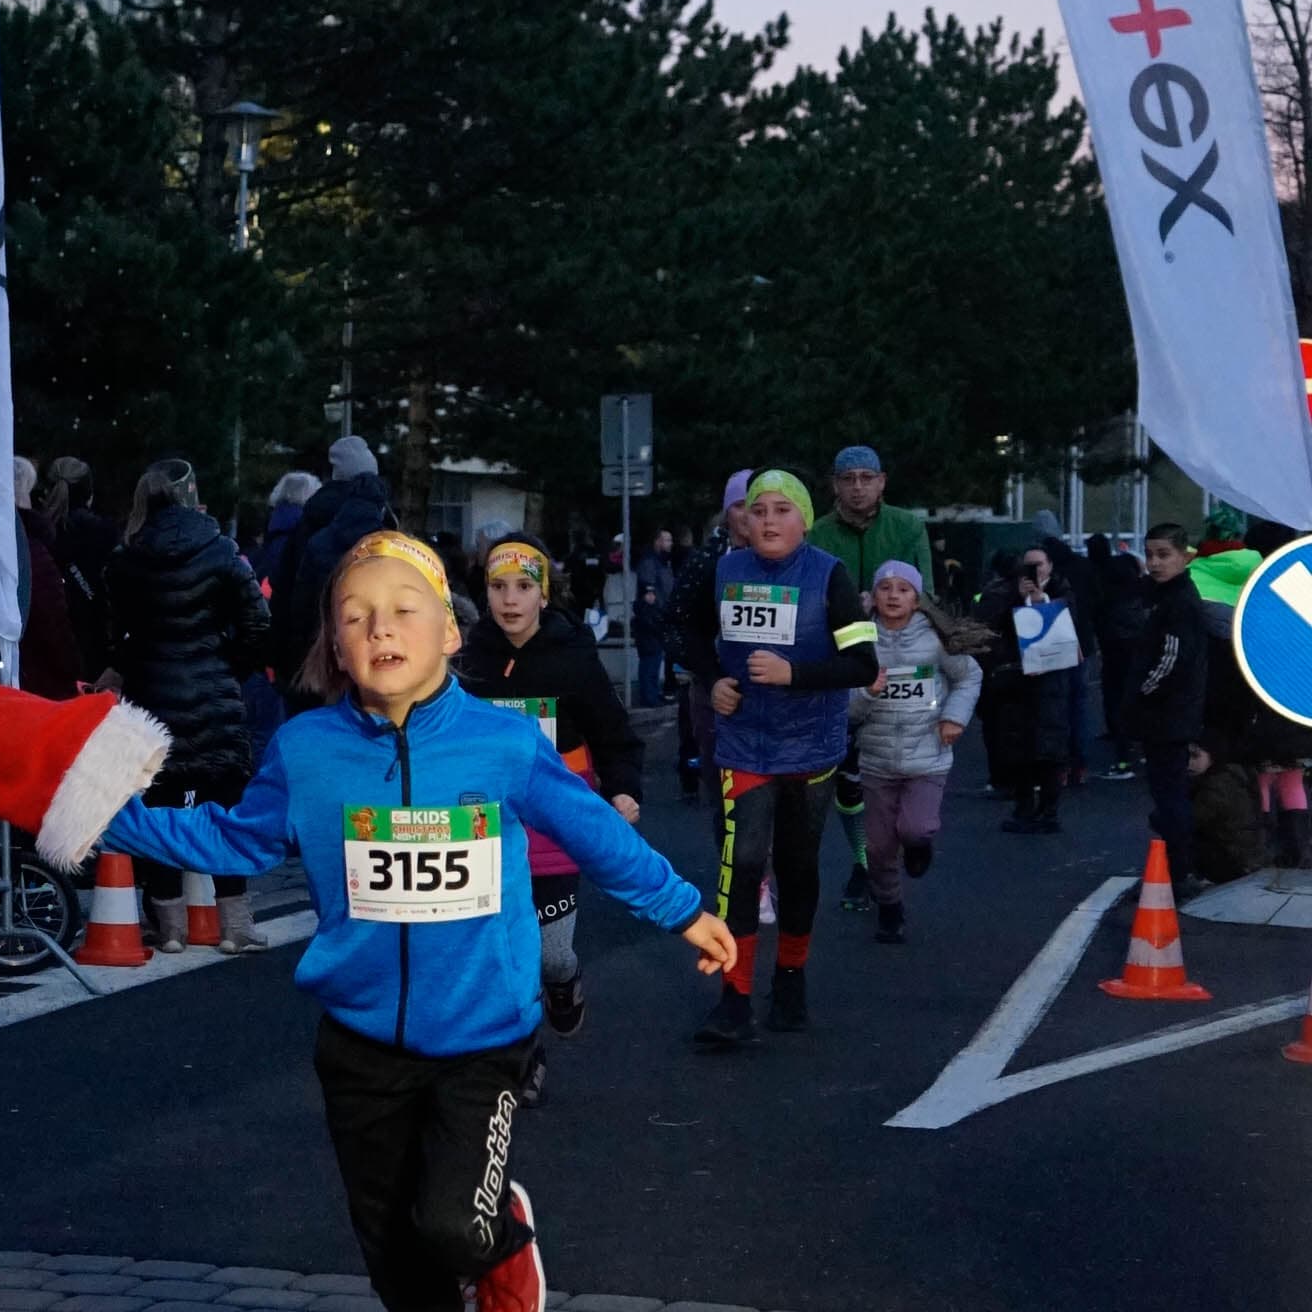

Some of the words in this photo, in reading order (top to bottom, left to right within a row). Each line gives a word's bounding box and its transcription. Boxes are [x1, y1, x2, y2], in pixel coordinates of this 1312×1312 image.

[732, 605, 776, 627] 3151
[413, 810, 450, 824] KIDS
[368, 850, 470, 892] 3155
